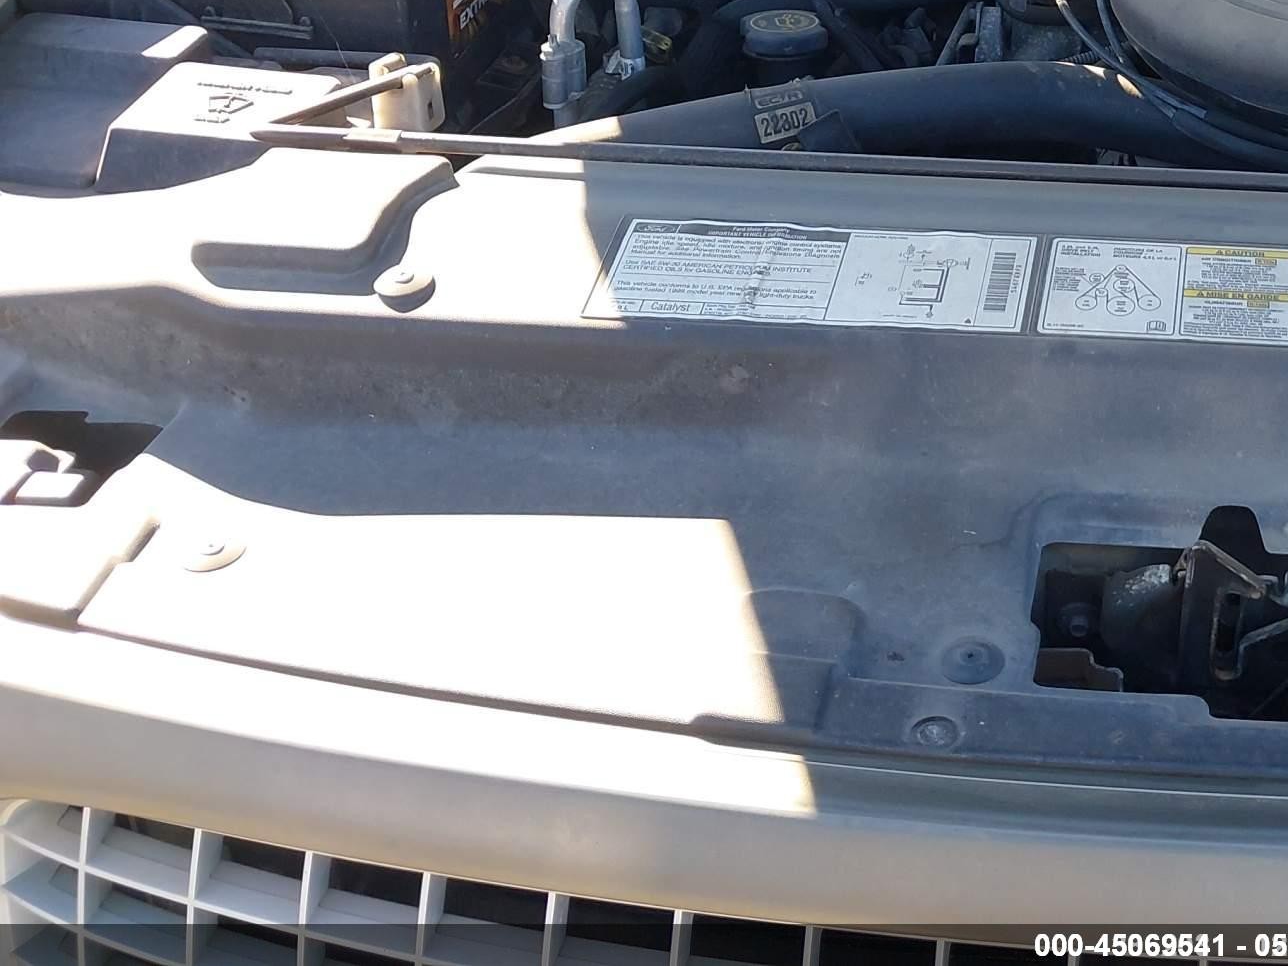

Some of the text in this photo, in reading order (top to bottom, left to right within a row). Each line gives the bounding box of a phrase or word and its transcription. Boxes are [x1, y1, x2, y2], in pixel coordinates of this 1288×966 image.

[1224, 249, 1265, 258] CAUTION
[1206, 291, 1230, 299] MISE
[650, 301, 691, 312] Catalyst
